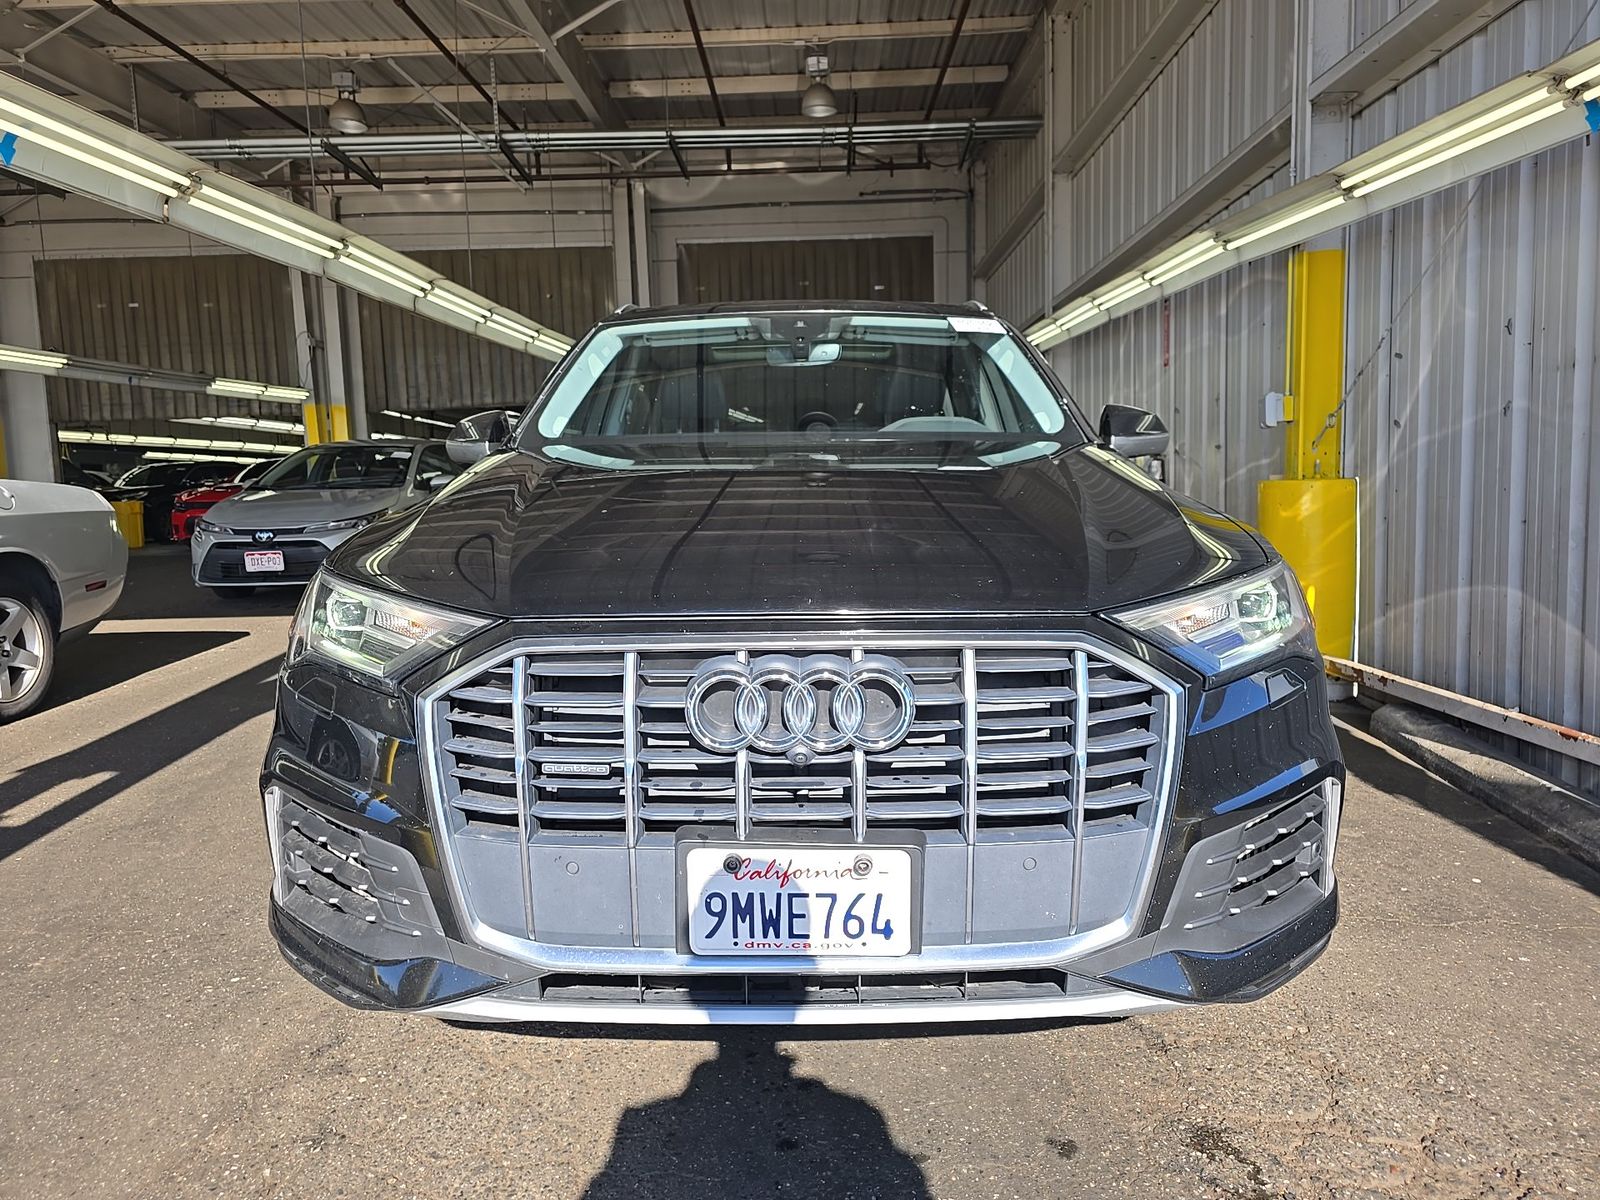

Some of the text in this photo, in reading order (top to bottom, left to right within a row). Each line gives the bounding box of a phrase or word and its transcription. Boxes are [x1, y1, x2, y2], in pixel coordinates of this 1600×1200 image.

[543, 764, 607, 774] quattro
[733, 857, 868, 889] California
[704, 891, 894, 941] 9MWE764
[744, 940, 854, 950] dmv.ca.gov
